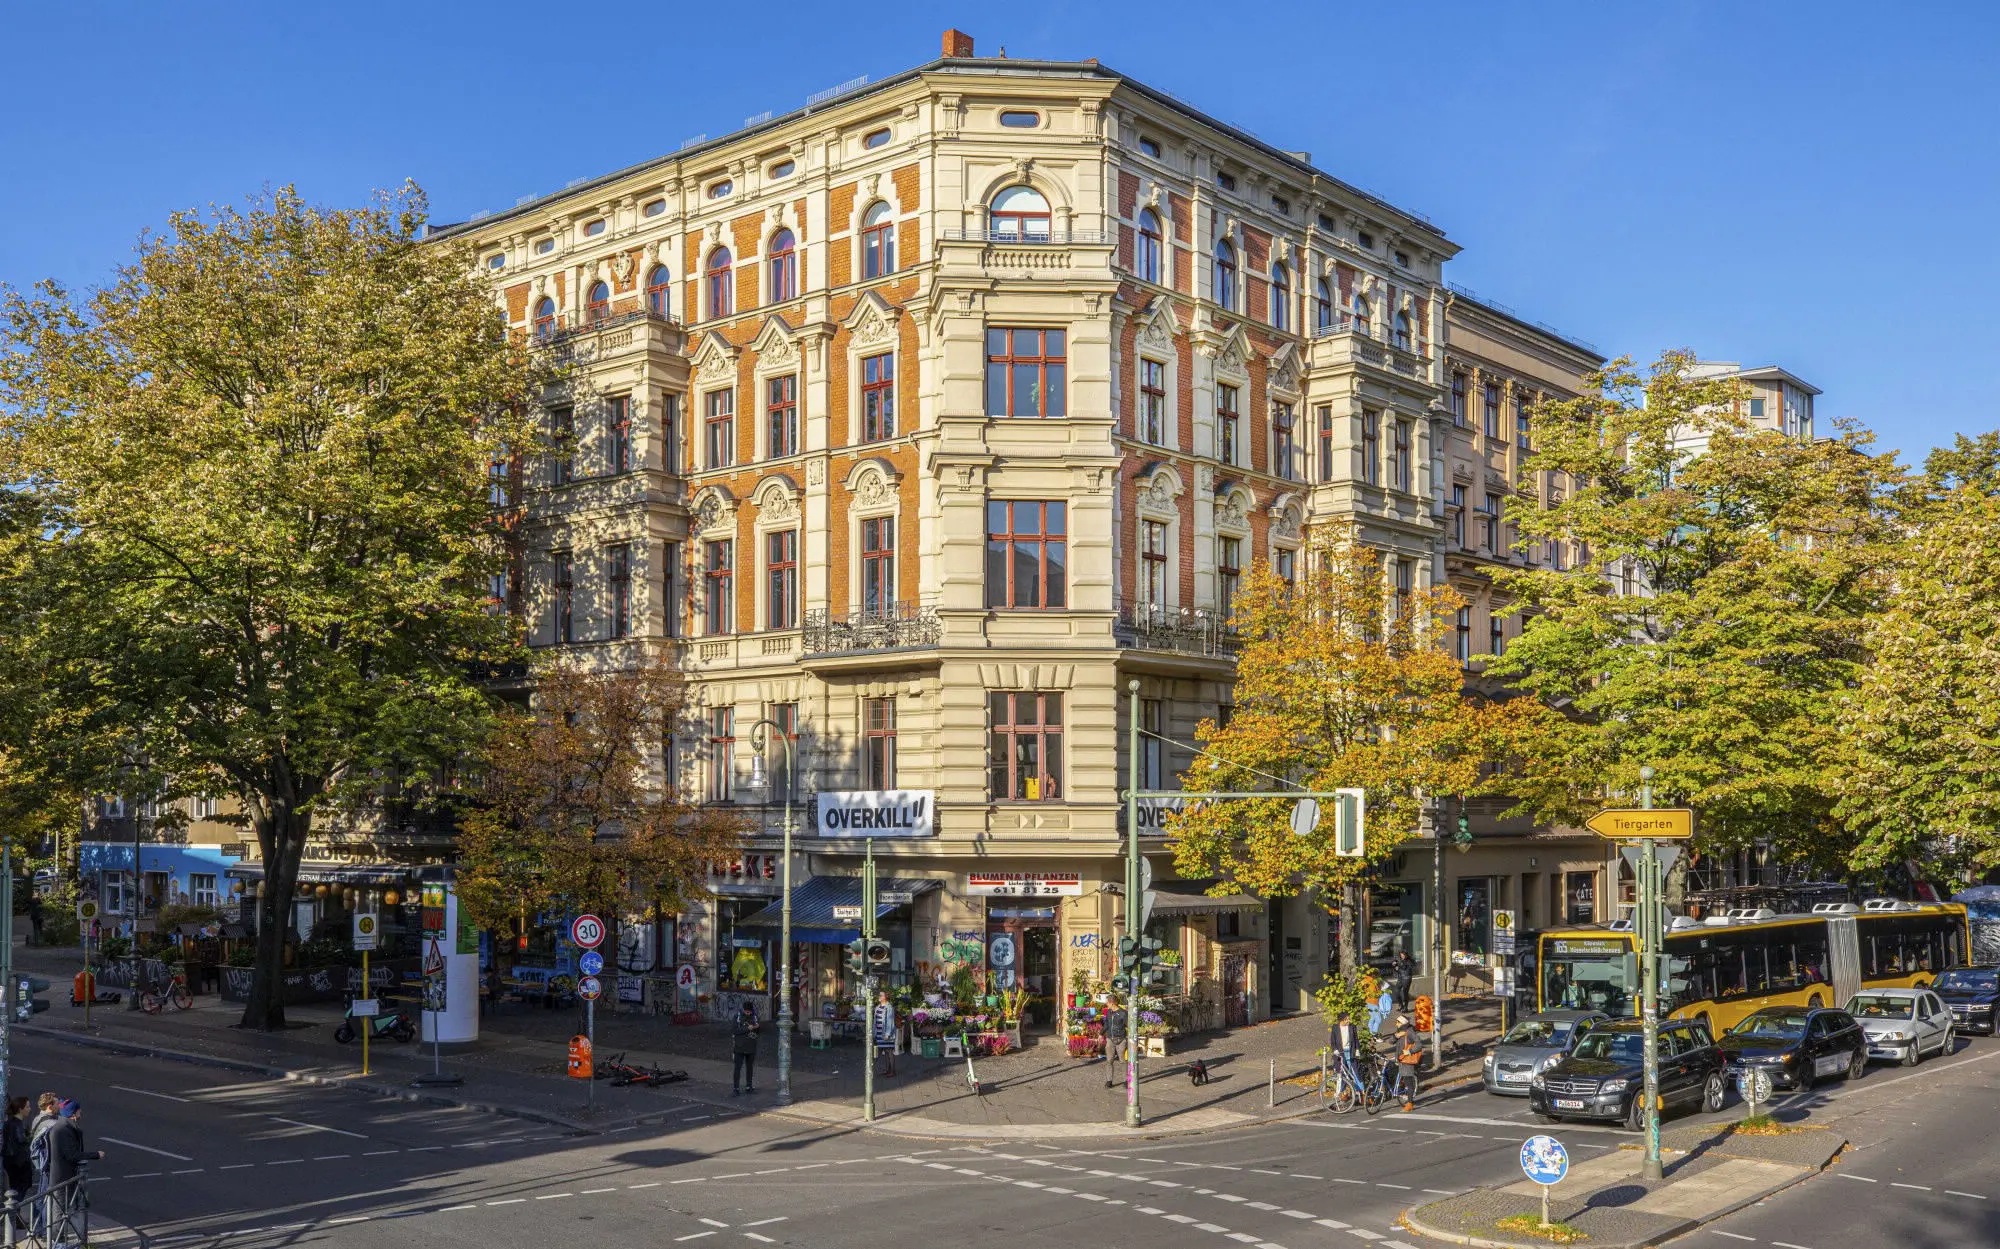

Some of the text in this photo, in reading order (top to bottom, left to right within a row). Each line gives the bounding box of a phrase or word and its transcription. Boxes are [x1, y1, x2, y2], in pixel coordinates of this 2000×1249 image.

[1614, 819, 1673, 831] Tiergarten
[1025, 873, 1079, 881] PFLANZEN
[579, 923, 598, 940] 30
